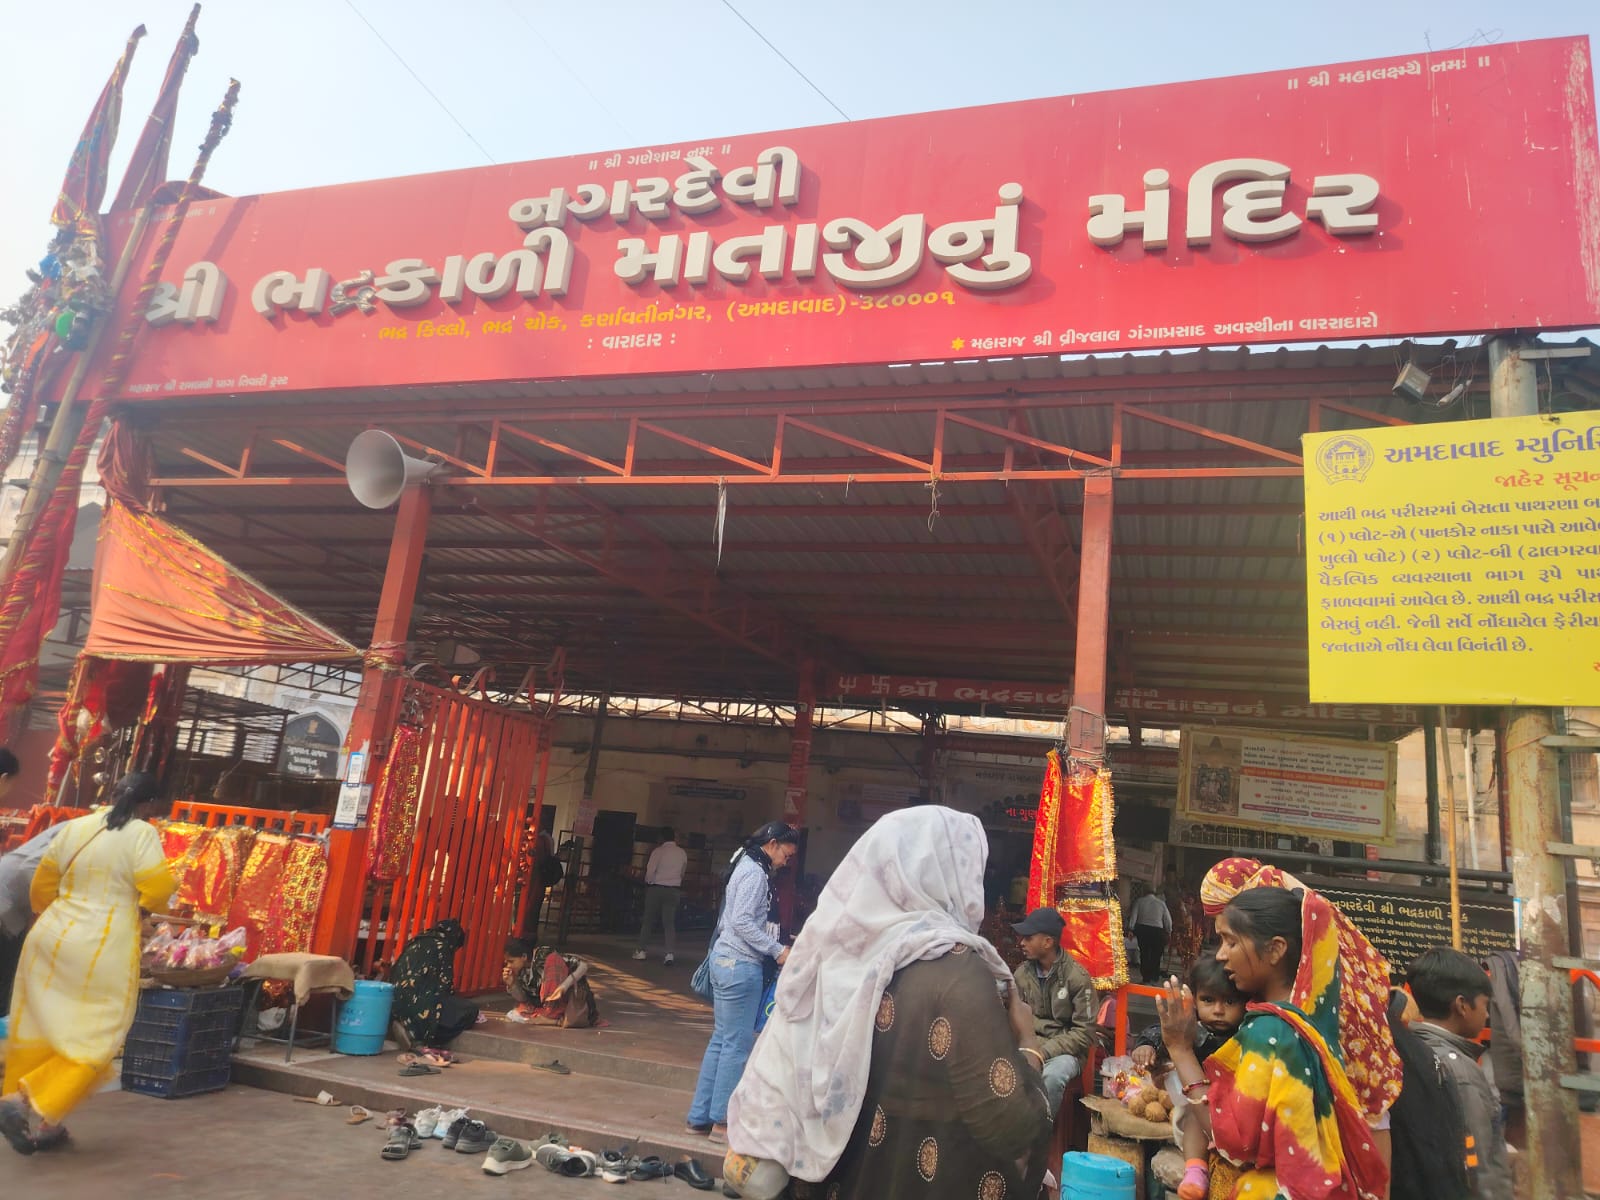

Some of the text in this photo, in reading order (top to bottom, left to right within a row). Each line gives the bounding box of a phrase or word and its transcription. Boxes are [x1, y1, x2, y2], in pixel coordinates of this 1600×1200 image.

[1307, 71, 1330, 87] શ્રી
[604, 153, 621, 169] શ્રી
[627, 150, 681, 166] ગણેશાય
[508, 146, 803, 230] નગરદેવી
[145, 157, 1380, 327] શ્રી ભદ્રકાળી માતાજીનું મંદિર
[378, 325, 408, 340] ભદ્ર
[416, 318, 470, 338] કિલ્લો,
[482, 319, 513, 334] ભદ્ર
[524, 312, 568, 332] ચોક,
[971, 336, 1026, 350] મહારાજ
[1033, 330, 1052, 346] શ્રી
[1128, 324, 1206, 341] ગંગાપ્રસાદ
[1213, 316, 1293, 335] અવસ્થીના
[1384, 440, 1505, 463] અમદાવાદ
[1495, 469, 1545, 487] જાહેર
[1319, 506, 1356, 521] આથી
[1361, 509, 1386, 519] ભદ્ર
[1391, 501, 1456, 517] પરીસરમાં
[1461, 500, 1510, 514] બેસતા
[1515, 499, 1578, 512] પાથરણા
[1480, 525, 1519, 536] નાકા
[1522, 519, 1555, 534] પાસે
[1319, 549, 1358, 570] ખુલ્લો
[1392, 571, 1472, 584] વ્યવસ્થાના
[1485, 570, 1525, 581] ભાગ
[1538, 565, 1562, 582] રૂપે
[1321, 593, 1395, 610] ફાળવવામાં
[1400, 591, 1449, 606] આવેલ
[1452, 590, 1472, 605] છે.
[1477, 589, 1520, 604] આથી
[1525, 593, 1554, 605] ભદ્ર
[1321, 615, 1361, 635] બેસવું
[1365, 614, 1401, 629] નહી.
[1407, 614, 1440, 629] જેની
[1322, 637, 1382, 652] જનતાએ
[1422, 637, 1453, 652] લેવા
[1457, 636, 1508, 651] વિનંતી
[1380, 903, 1394, 915] શ્રી
[1398, 907, 1443, 921] ભદ્રકાળી
